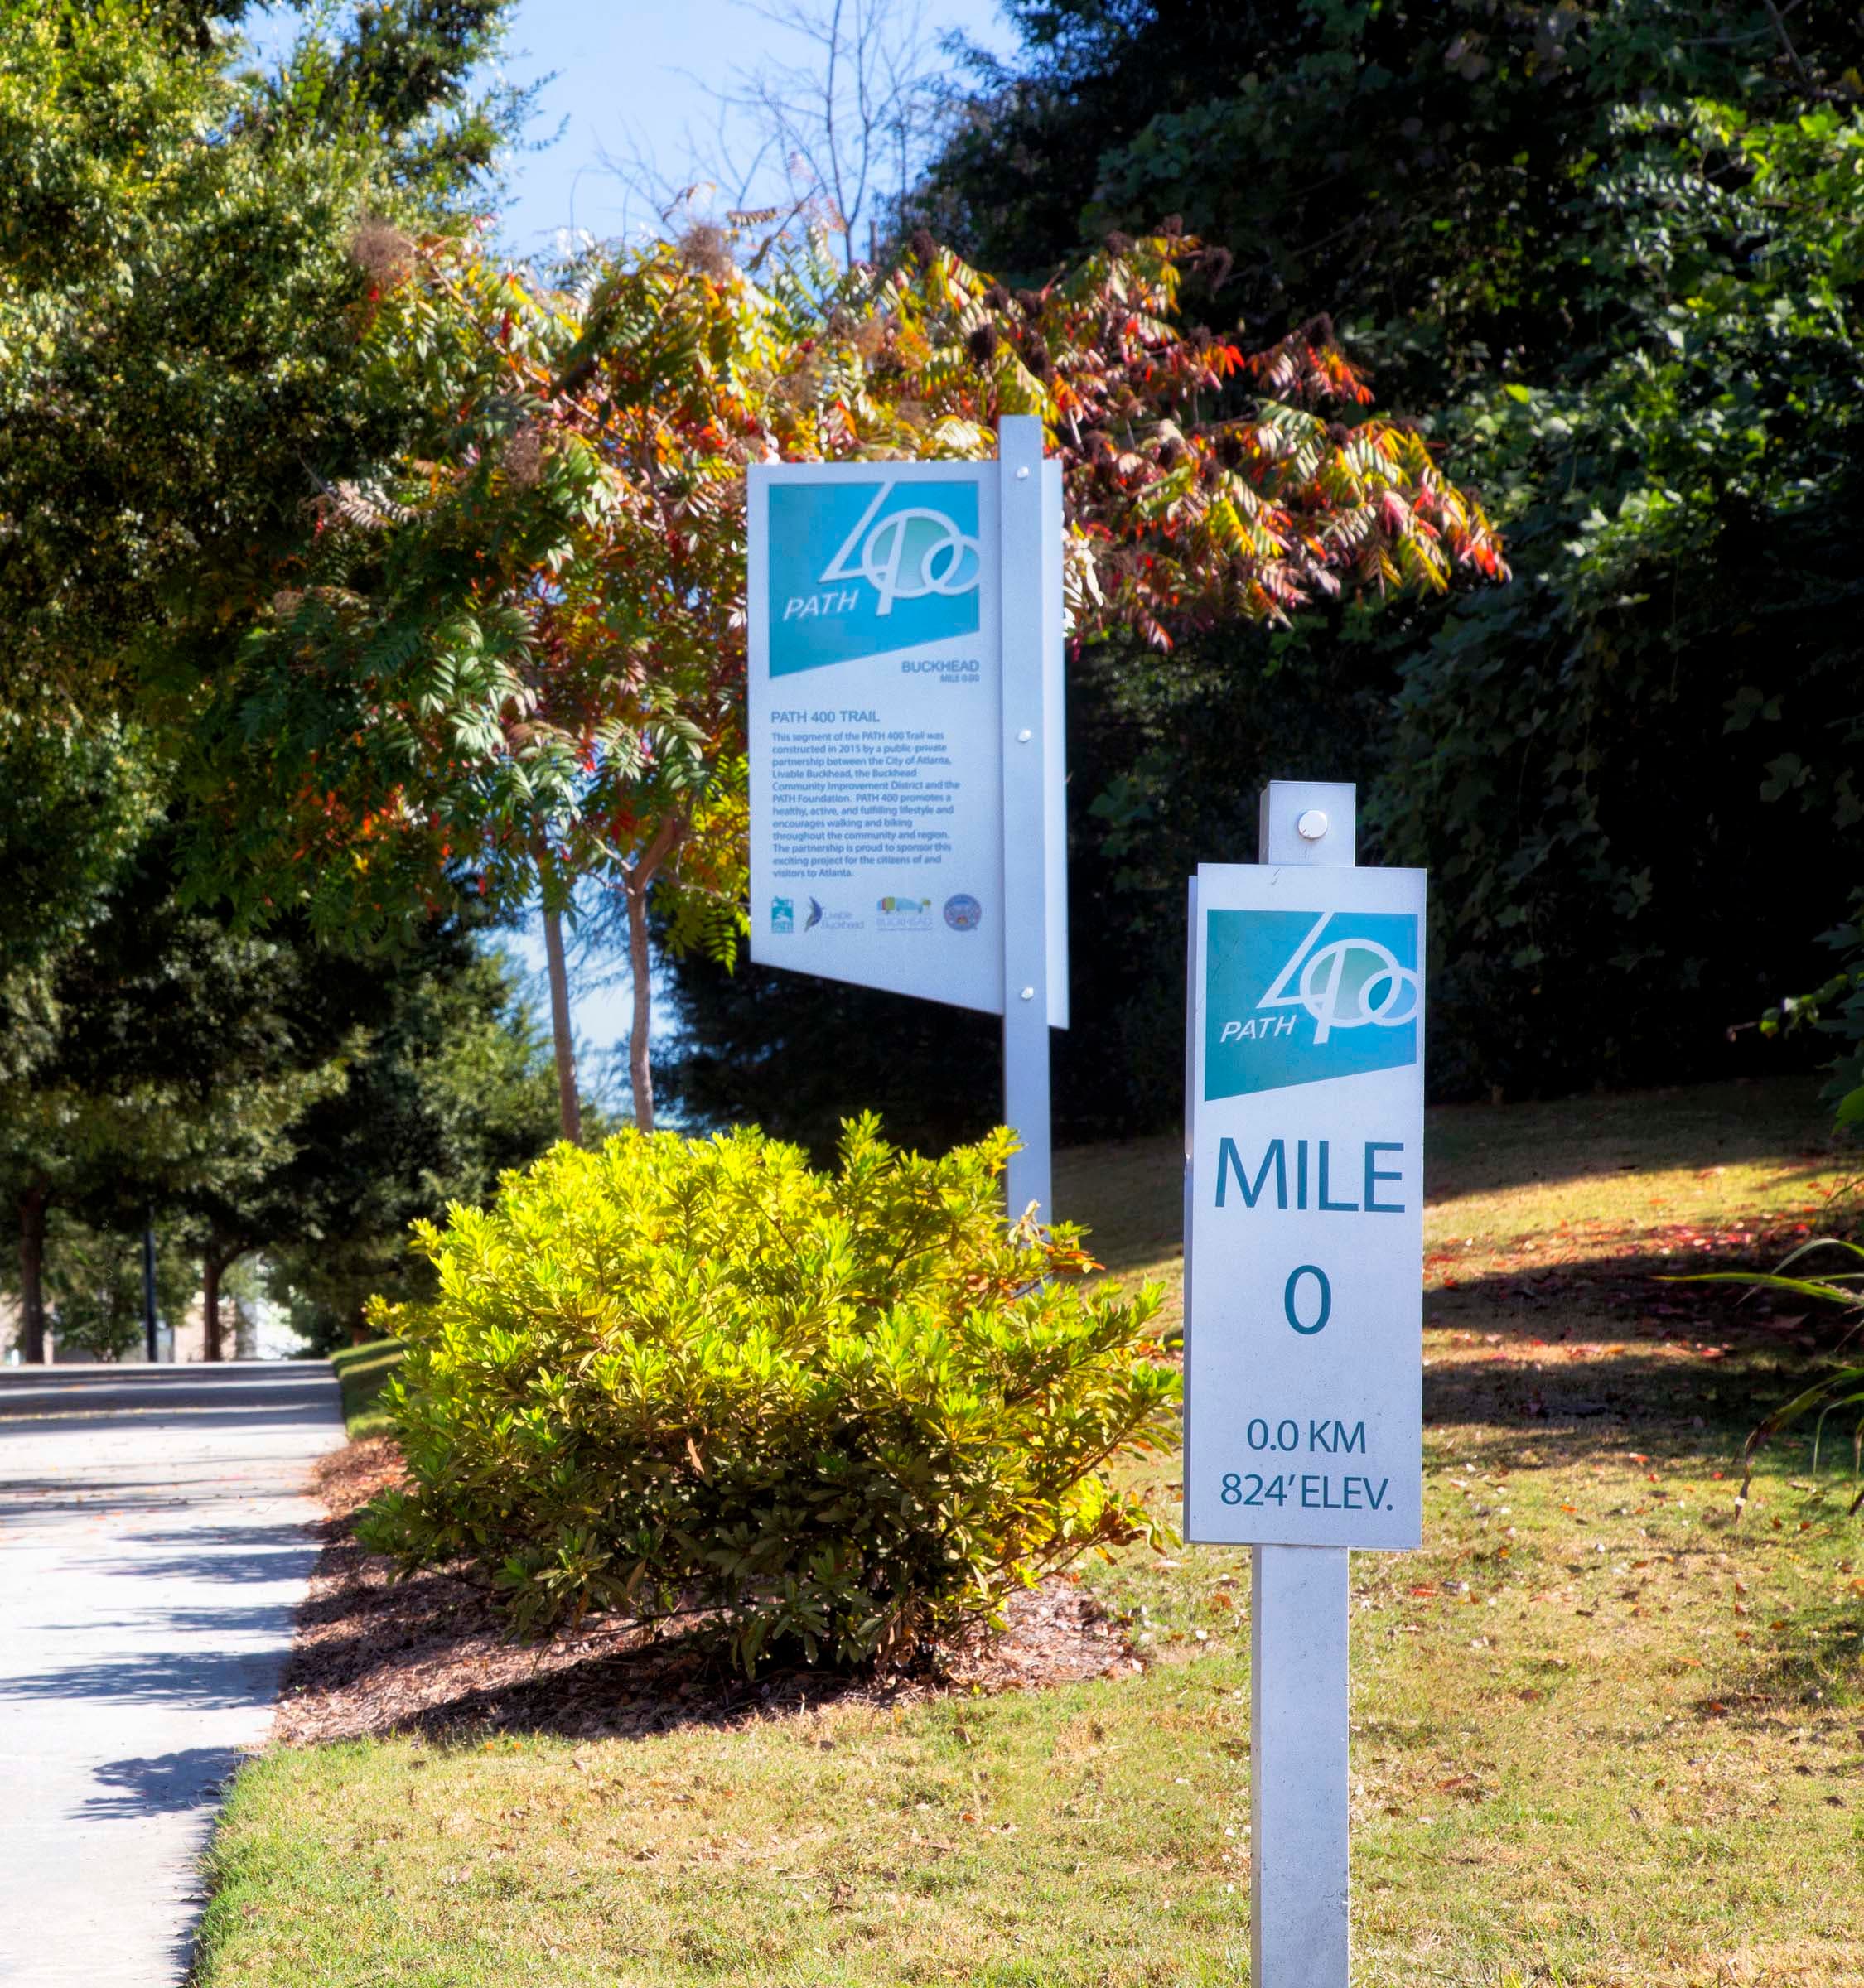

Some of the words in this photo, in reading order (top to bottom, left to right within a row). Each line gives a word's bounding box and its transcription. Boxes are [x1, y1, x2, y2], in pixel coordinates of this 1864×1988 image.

[818, 480, 981, 616] 400
[783, 589, 859, 622] PATH
[901, 660, 979, 673] BUCKHEAD
[940, 674, 959, 683] MILE
[770, 711, 808, 723] PATH
[810, 711, 836, 723] 400
[839, 710, 881, 722] TRAIL
[772, 732, 791, 741] This
[792, 732, 832, 743] segment
[833, 732, 844, 741] of
[844, 732, 862, 741] the
[862, 731, 886, 741] PATH
[887, 731, 905, 740] 400
[906, 731, 925, 740] Trail
[772, 745, 828, 753] constructed
[828, 745, 838, 753] in
[839, 745, 862, 753] 2015
[862, 744, 876, 755] by
[772, 757, 826, 768] partnership
[827, 757, 867, 765] between
[868, 756, 885, 765] the
[885, 756, 905, 767] City
[905, 756, 917, 765] of
[917, 756, 953, 765] Atlanta,
[772, 770, 805, 778] Livable
[806, 770, 854, 779] Buckhead,
[854, 769, 872, 778] the
[872, 769, 918, 777] Buckhead
[772, 782, 827, 792] Community
[828, 781, 890, 792] Improvement
[891, 781, 925, 789] District
[925, 781, 944, 789] and
[944, 781, 961, 789] the
[773, 794, 797, 803] PATH
[797, 794, 852, 803] Foundation.
[856, 794, 880, 802] PATH
[881, 794, 900, 802] 400
[900, 794, 945, 803] promotes
[773, 807, 809, 817] healthy,
[809, 807, 840, 816] active,
[840, 806, 860, 815] and
[860, 806, 898, 817] fulfilling
[899, 806, 935, 816] lifestyle
[935, 805, 955, 814] and
[772, 821, 826, 829] encourages
[827, 818, 863, 829] walking
[864, 818, 883, 827] and
[884, 818, 914, 828] biking
[773, 832, 826, 842] throughout
[827, 831, 843, 840] the
[844, 831, 897, 842] community
[897, 831, 917, 839] and
[917, 830, 950, 841] region.
[773, 844, 791, 852] The
[791, 843, 846, 854] partnership
[846, 843, 855, 852] is
[855, 843, 884, 854] proud
[885, 843, 896, 852] to
[896, 845, 934, 853] sponsor
[934, 842, 953, 852] this
[773, 856, 809, 866] exciting
[810, 856, 844, 866] project
[845, 856, 859, 864] for
[860, 856, 876, 864] the
[876, 856, 911, 864] citizens
[912, 856, 924, 864] of
[925, 855, 943, 864] and
[773, 869, 805, 877] visitors
[807, 868, 818, 877] to
[819, 868, 854, 876] Atlanta.
[1256, 912, 1417, 1044] 400
[1219, 1015, 1297, 1043] PATH
[1214, 1137, 1406, 1213] MILE
[1284, 1264, 1331, 1335] 0
[1247, 1418, 1299, 1451] 0.0
[1309, 1420, 1366, 1455] KM
[1301, 1475, 1393, 1512] ELEV.
